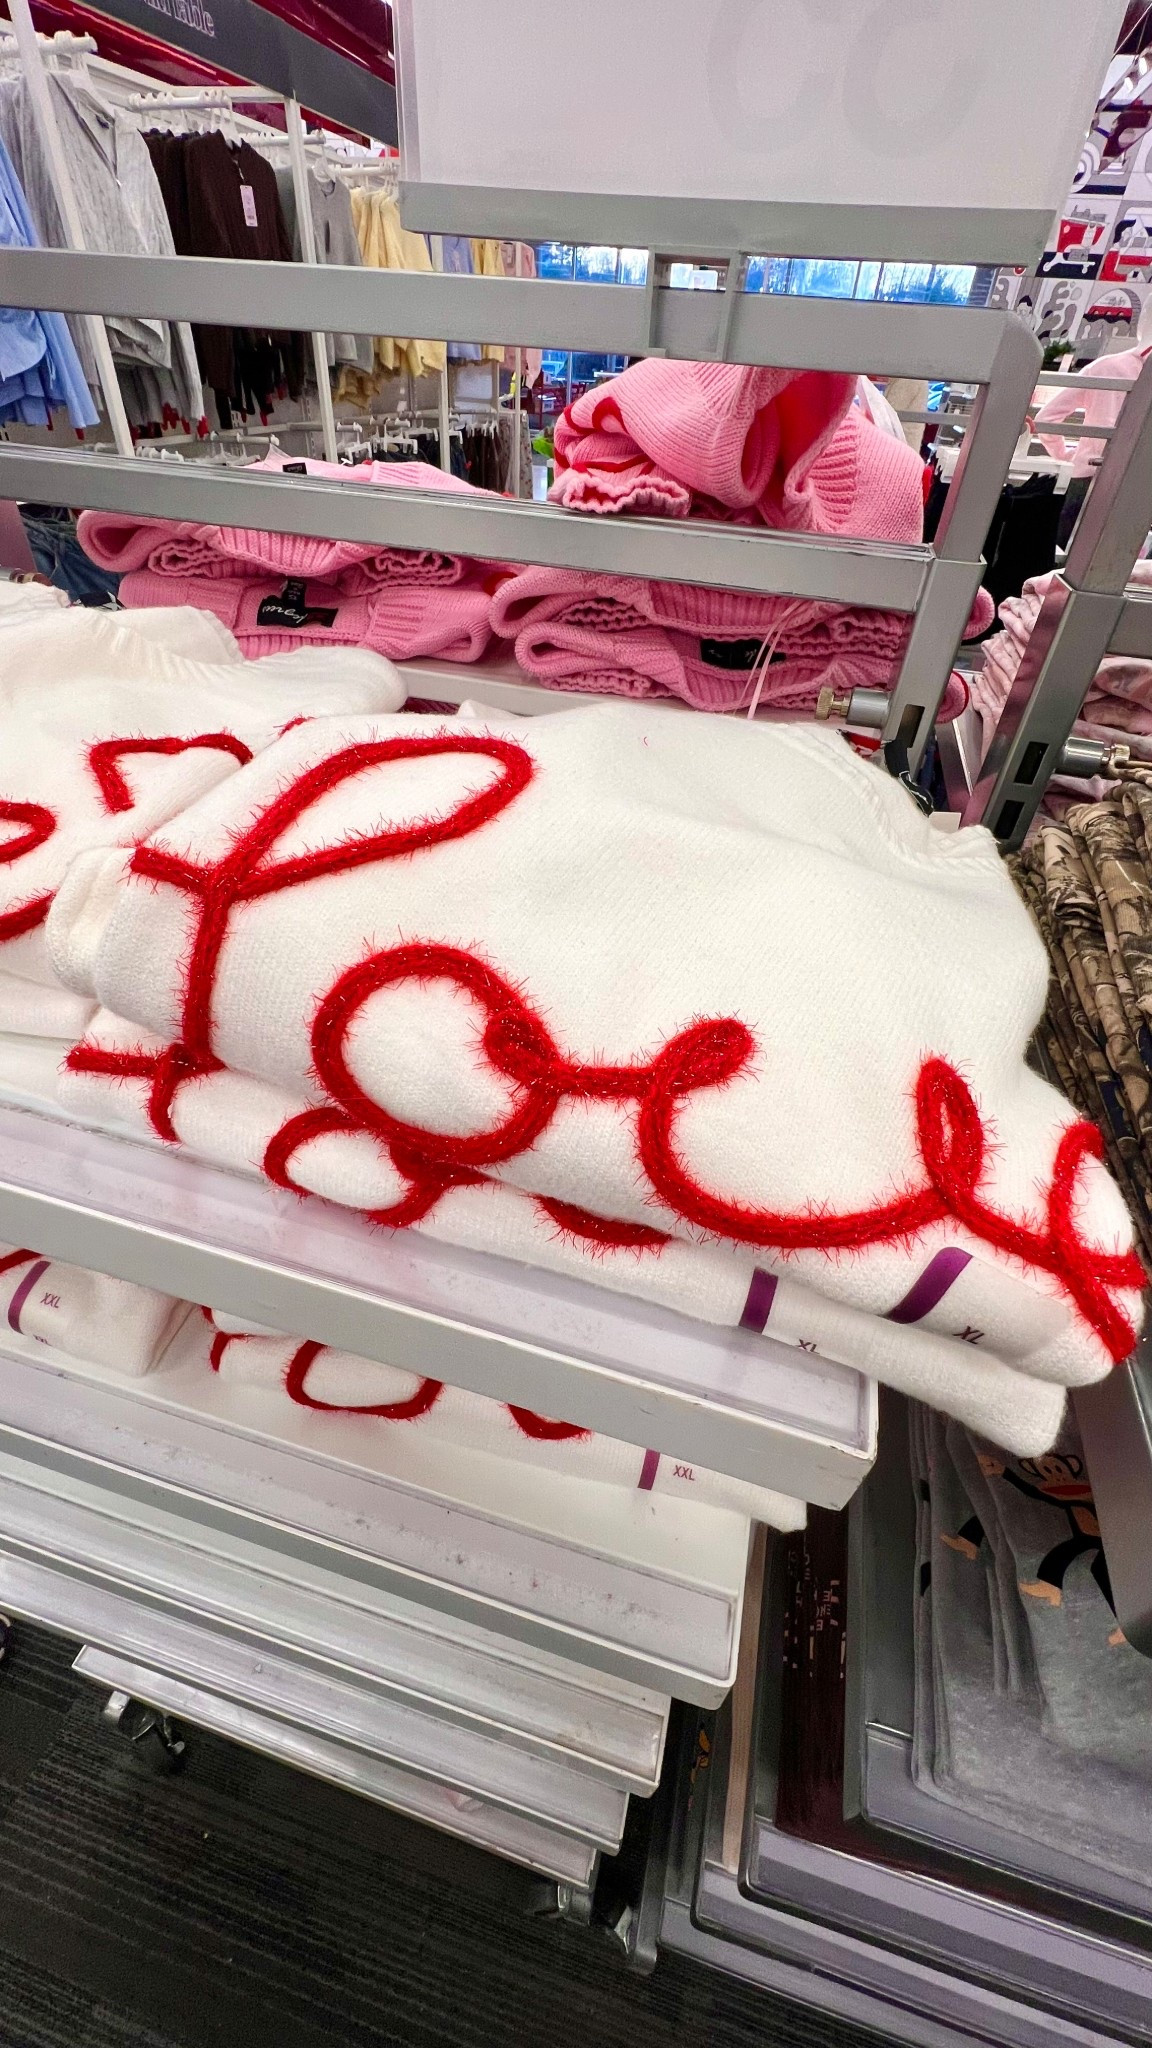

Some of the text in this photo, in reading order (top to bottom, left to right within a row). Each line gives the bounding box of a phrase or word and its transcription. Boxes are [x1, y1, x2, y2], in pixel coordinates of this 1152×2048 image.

[40, 1292, 61, 1309] XXL
[952, 1325, 985, 1345] XL
[797, 1338, 820, 1355] XL
[673, 1464, 695, 1482] XXL
